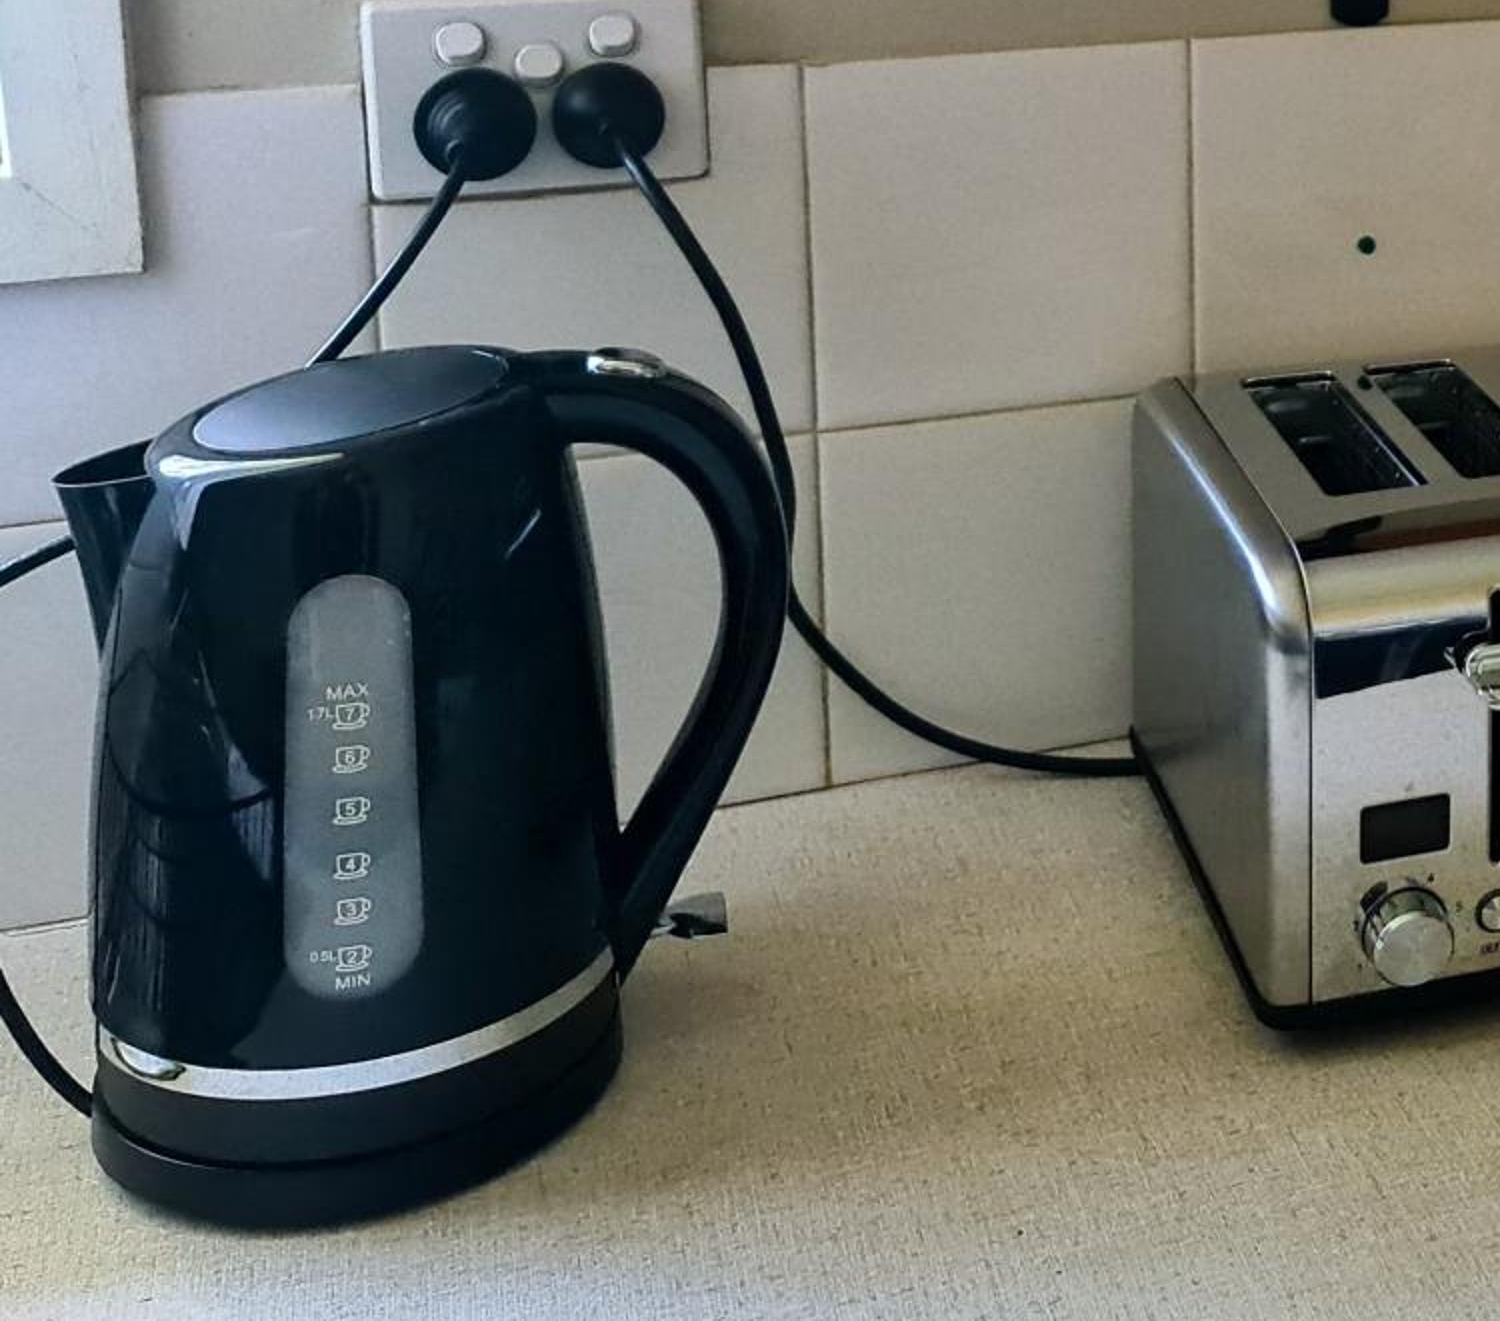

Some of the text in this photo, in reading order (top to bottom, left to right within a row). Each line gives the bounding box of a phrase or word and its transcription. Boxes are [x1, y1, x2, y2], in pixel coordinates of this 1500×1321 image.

[325, 682, 369, 700] MAX
[344, 751, 355, 765] 6
[344, 802, 355, 816] 5
[345, 857, 355, 871] 4
[345, 903, 356, 917] 3
[346, 949, 357, 964] 2
[335, 973, 371, 991] MIN
